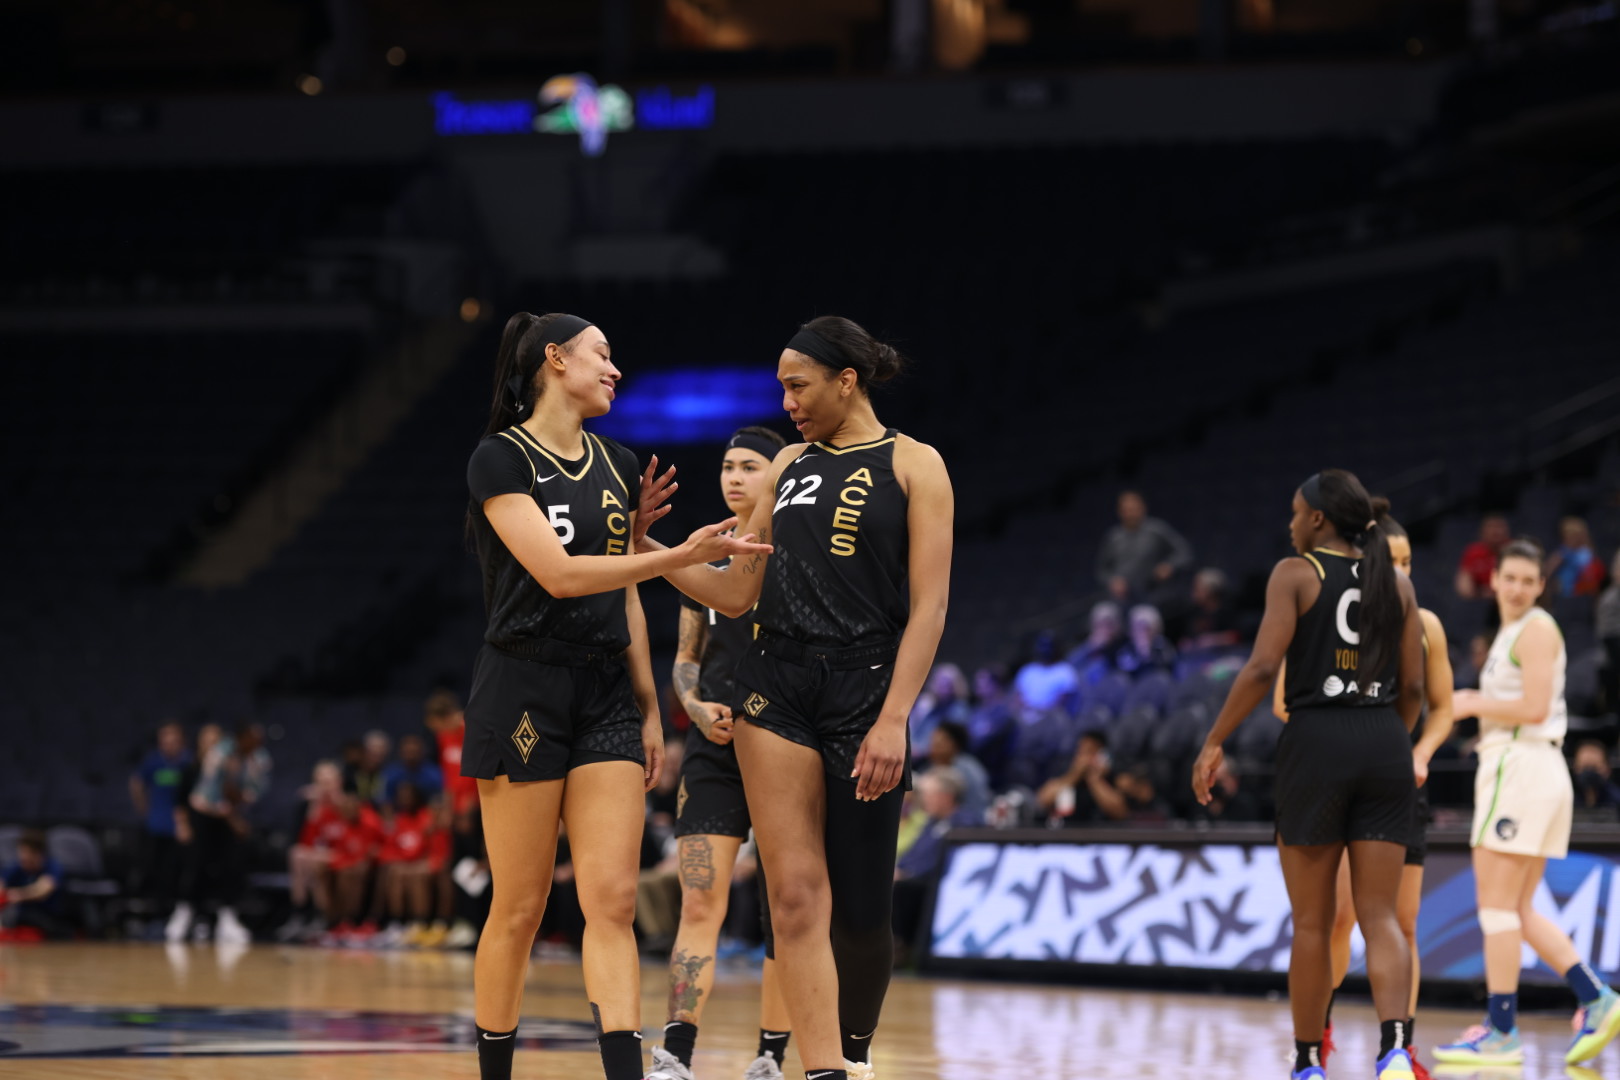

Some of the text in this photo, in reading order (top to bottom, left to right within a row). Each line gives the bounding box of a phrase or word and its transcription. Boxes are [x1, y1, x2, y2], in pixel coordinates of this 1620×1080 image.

[772, 475, 822, 515] 22
[830, 467, 873, 557] ACES
[548, 504, 575, 546] 5
[601, 489, 627, 555] ACE
[1335, 648, 1359, 670] YOU
